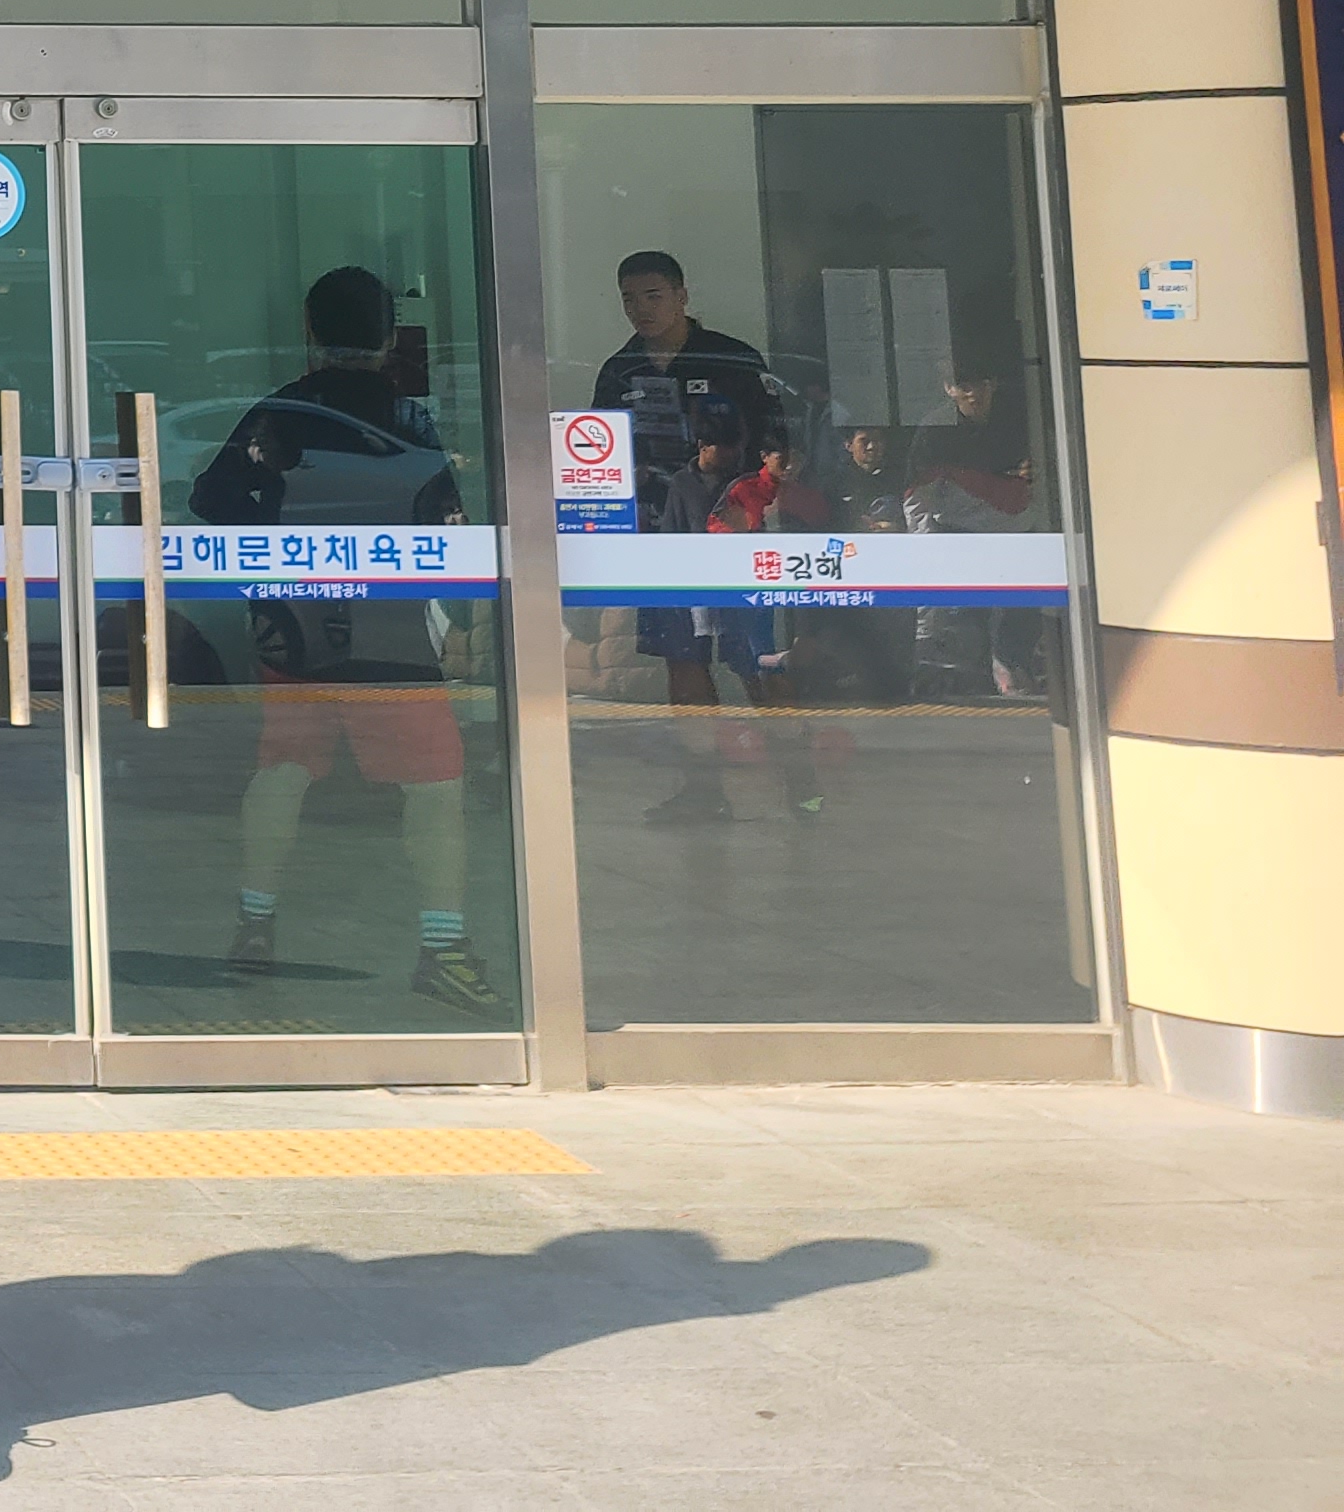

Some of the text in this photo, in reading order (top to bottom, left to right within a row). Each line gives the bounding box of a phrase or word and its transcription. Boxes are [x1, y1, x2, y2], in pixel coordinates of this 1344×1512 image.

[560, 468, 622, 484] 금연구역
[160, 534, 448, 571] 김해문화체육관
[785, 551, 842, 580] 김해
[256, 583, 369, 599] 김해시도시개발공사
[762, 590, 874, 606] 김해시도시개발공사
